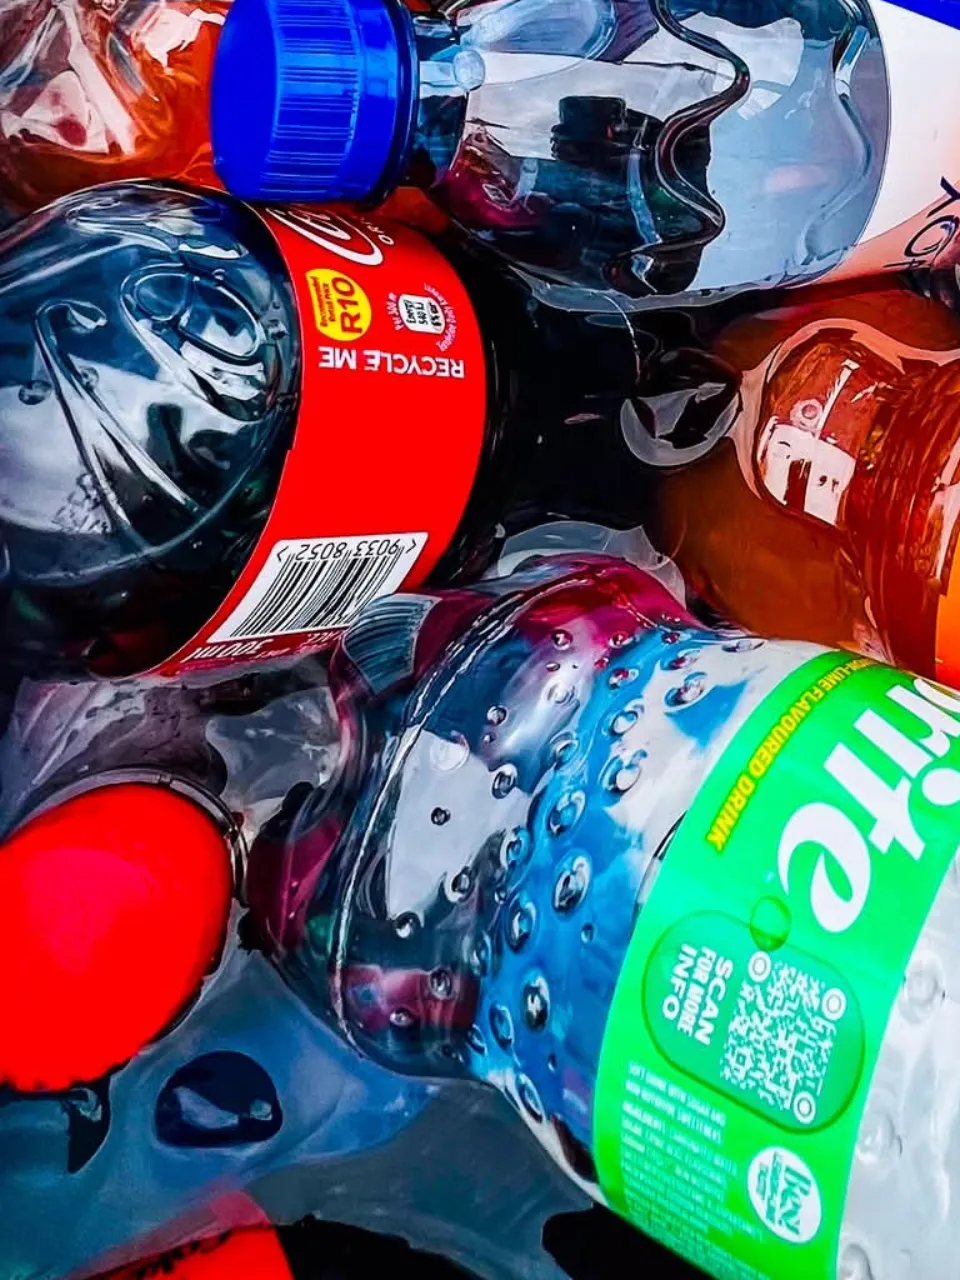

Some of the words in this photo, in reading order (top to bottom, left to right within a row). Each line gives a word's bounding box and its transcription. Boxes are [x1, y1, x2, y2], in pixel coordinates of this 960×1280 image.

[330, 276, 364, 335] R10
[318, 345, 357, 370] ME
[363, 349, 466, 379] RECYCLE
[296, 541, 348, 561] 8052
[353, 538, 401, 557] 9033
[748, 686, 824, 779] FLAVOURED
[704, 775, 756, 853] DRINK
[661, 943, 699, 1021] INFO
[695, 946, 728, 987] FOR
[676, 984, 706, 1038] MORE
[693, 956, 734, 1046] SCAN
